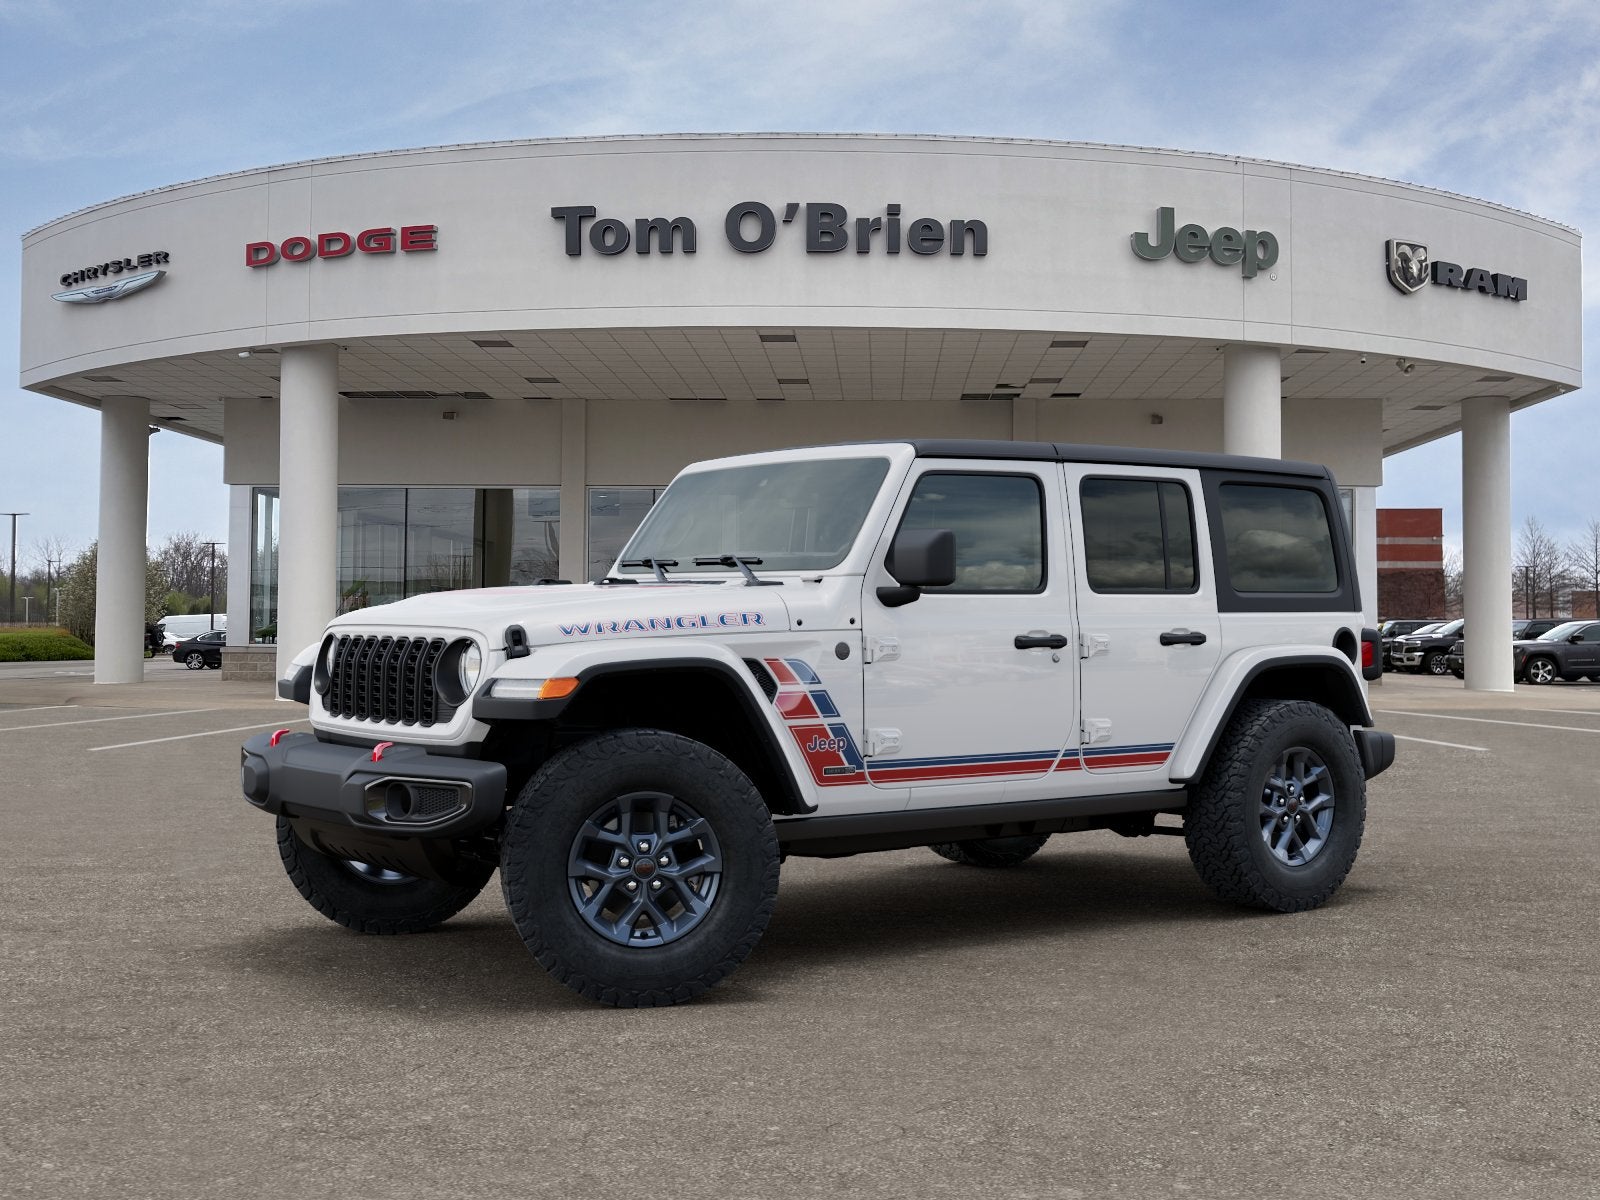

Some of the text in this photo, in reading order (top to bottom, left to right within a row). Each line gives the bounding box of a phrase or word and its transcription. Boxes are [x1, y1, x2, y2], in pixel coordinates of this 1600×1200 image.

[246, 225, 438, 268] DODGE
[551, 201, 988, 256] Tom O'Brien
[1131, 207, 1279, 278] Jeep
[60, 251, 170, 287] CHRYSLER
[1431, 260, 1527, 300] RAM
[558, 611, 766, 636] WRANGLER
[806, 735, 848, 754] Jeep
